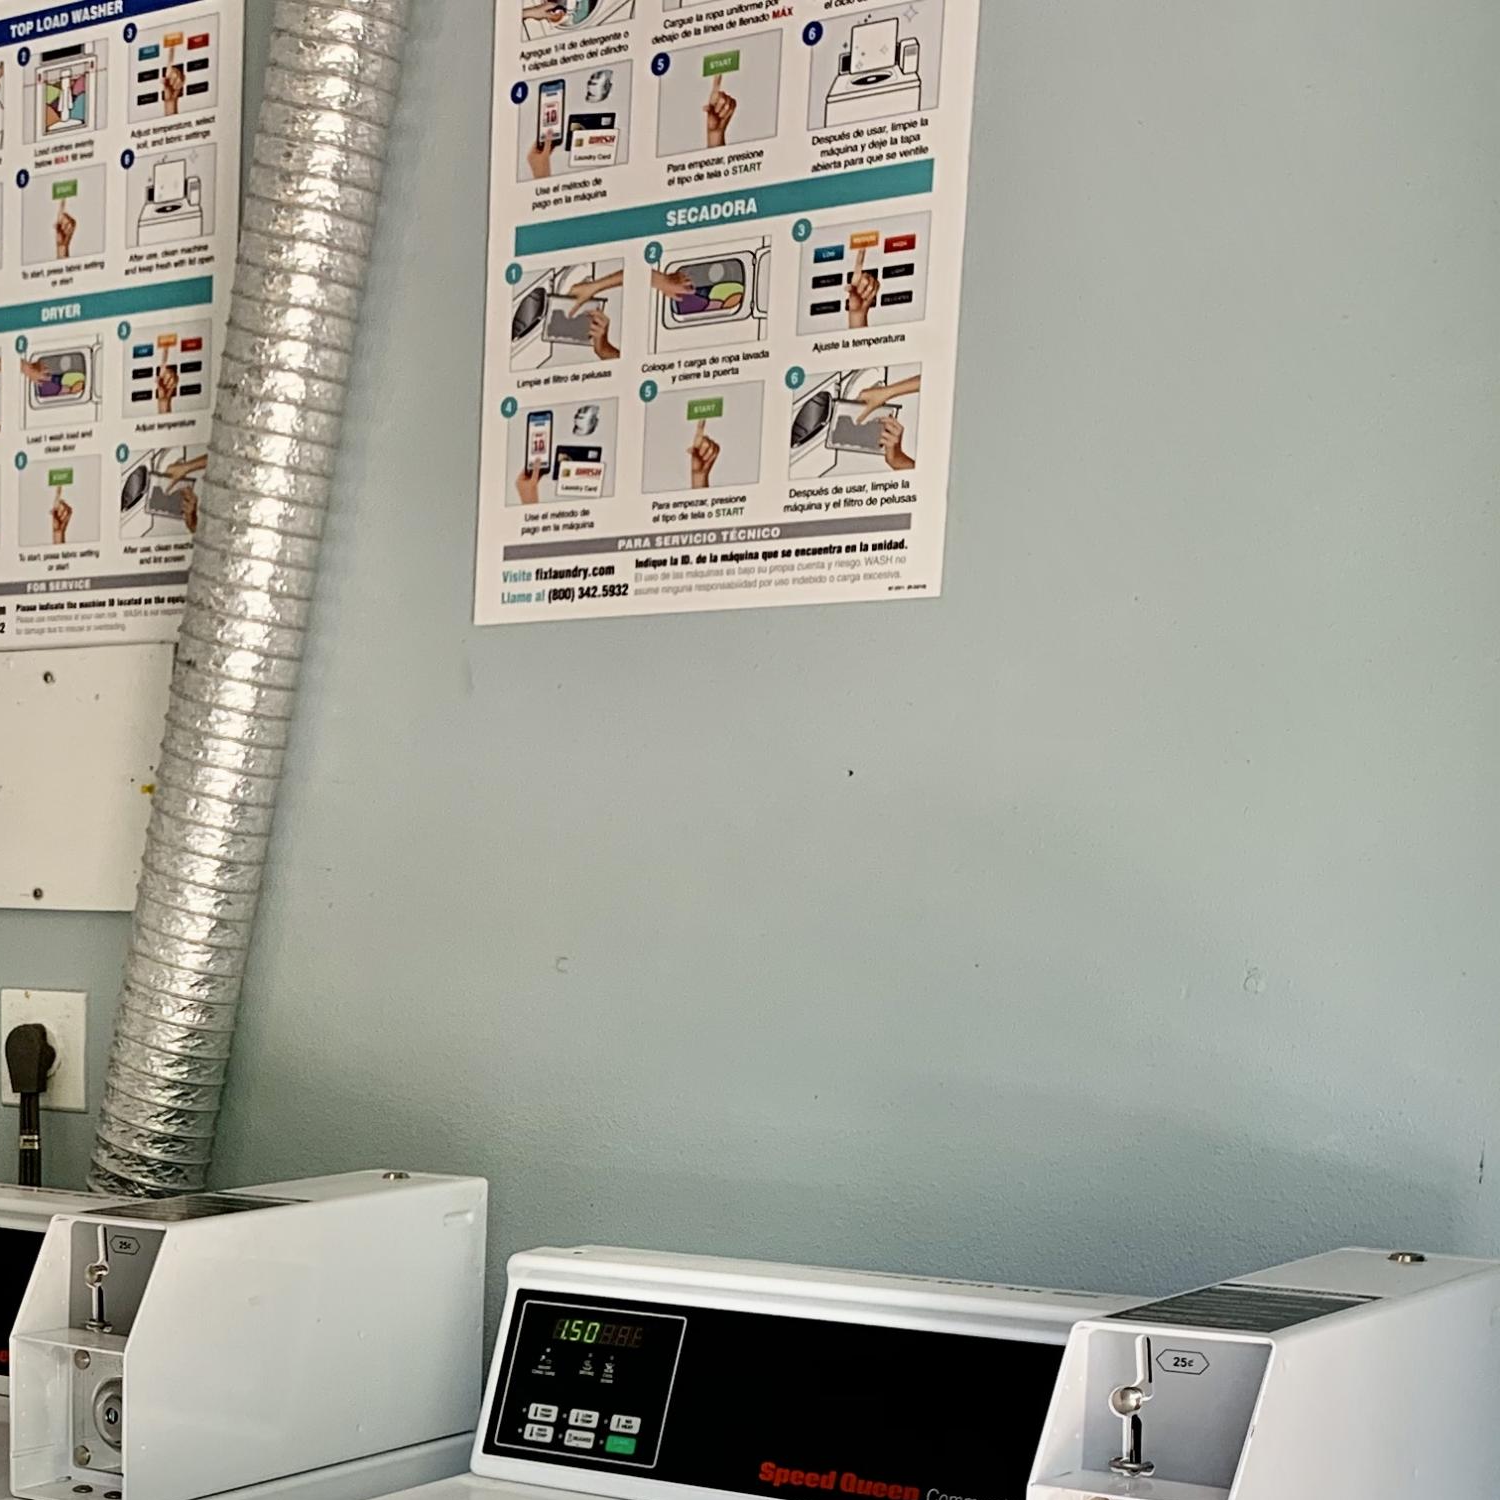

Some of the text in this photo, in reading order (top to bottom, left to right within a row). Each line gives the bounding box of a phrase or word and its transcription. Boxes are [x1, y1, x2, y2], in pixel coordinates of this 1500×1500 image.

[9, 1, 123, 39] TOP LOAD WASHER
[127, 28, 133, 38] 3
[809, 28, 816, 39] 6
[658, 58, 663, 70] 5
[516, 87, 522, 98] 4
[812, 117, 929, 146] Después de usar, limpie la
[820, 133, 920, 158] máquina y deje la tapa
[811, 146, 929, 173] abierta para que se ventile
[666, 198, 758, 228] SECADORA
[798, 224, 805, 236] 3
[649, 248, 656, 258] 2
[511, 269, 517, 278] 1
[41, 303, 81, 322] DRYER
[120, 325, 128, 336] 3
[18, 339, 24, 350] 2
[813, 334, 905, 353] Ajuste la temperatura
[642, 350, 769, 374] Coloque 1 carga de ropa lavada
[671, 375, 676, 384] y
[703, 369, 710, 378] la
[713, 366, 739, 378] puerta
[791, 372, 798, 384] 6
[644, 385, 651, 397] 5
[506, 402, 512, 412] 4
[789, 479, 910, 499] Después de usar, limpie la
[783, 494, 916, 513] máquina y el filtro de pelusas
[618, 526, 780, 550] PARA SERVICIO TÉCNICO
[635, 556, 667, 569] Indique
[670, 556, 678, 565] la
[696, 555, 706, 564] de
[709, 553, 718, 563] la
[720, 551, 759, 563] máquina
[761, 550, 778, 560] que
[781, 548, 791, 557] se
[795, 544, 842, 556] encuentra
[845, 545, 856, 553] en
[860, 542, 868, 552] la
[872, 538, 908, 551] unidad.
[502, 564, 615, 583] Visite fixlaundry.com
[26, 578, 91, 593] FOR SERVICE
[501, 583, 629, 604] Llame al (800) 342.5932
[1172, 1356, 1195, 1368] 25¢
[759, 1461, 836, 1490] Speed
